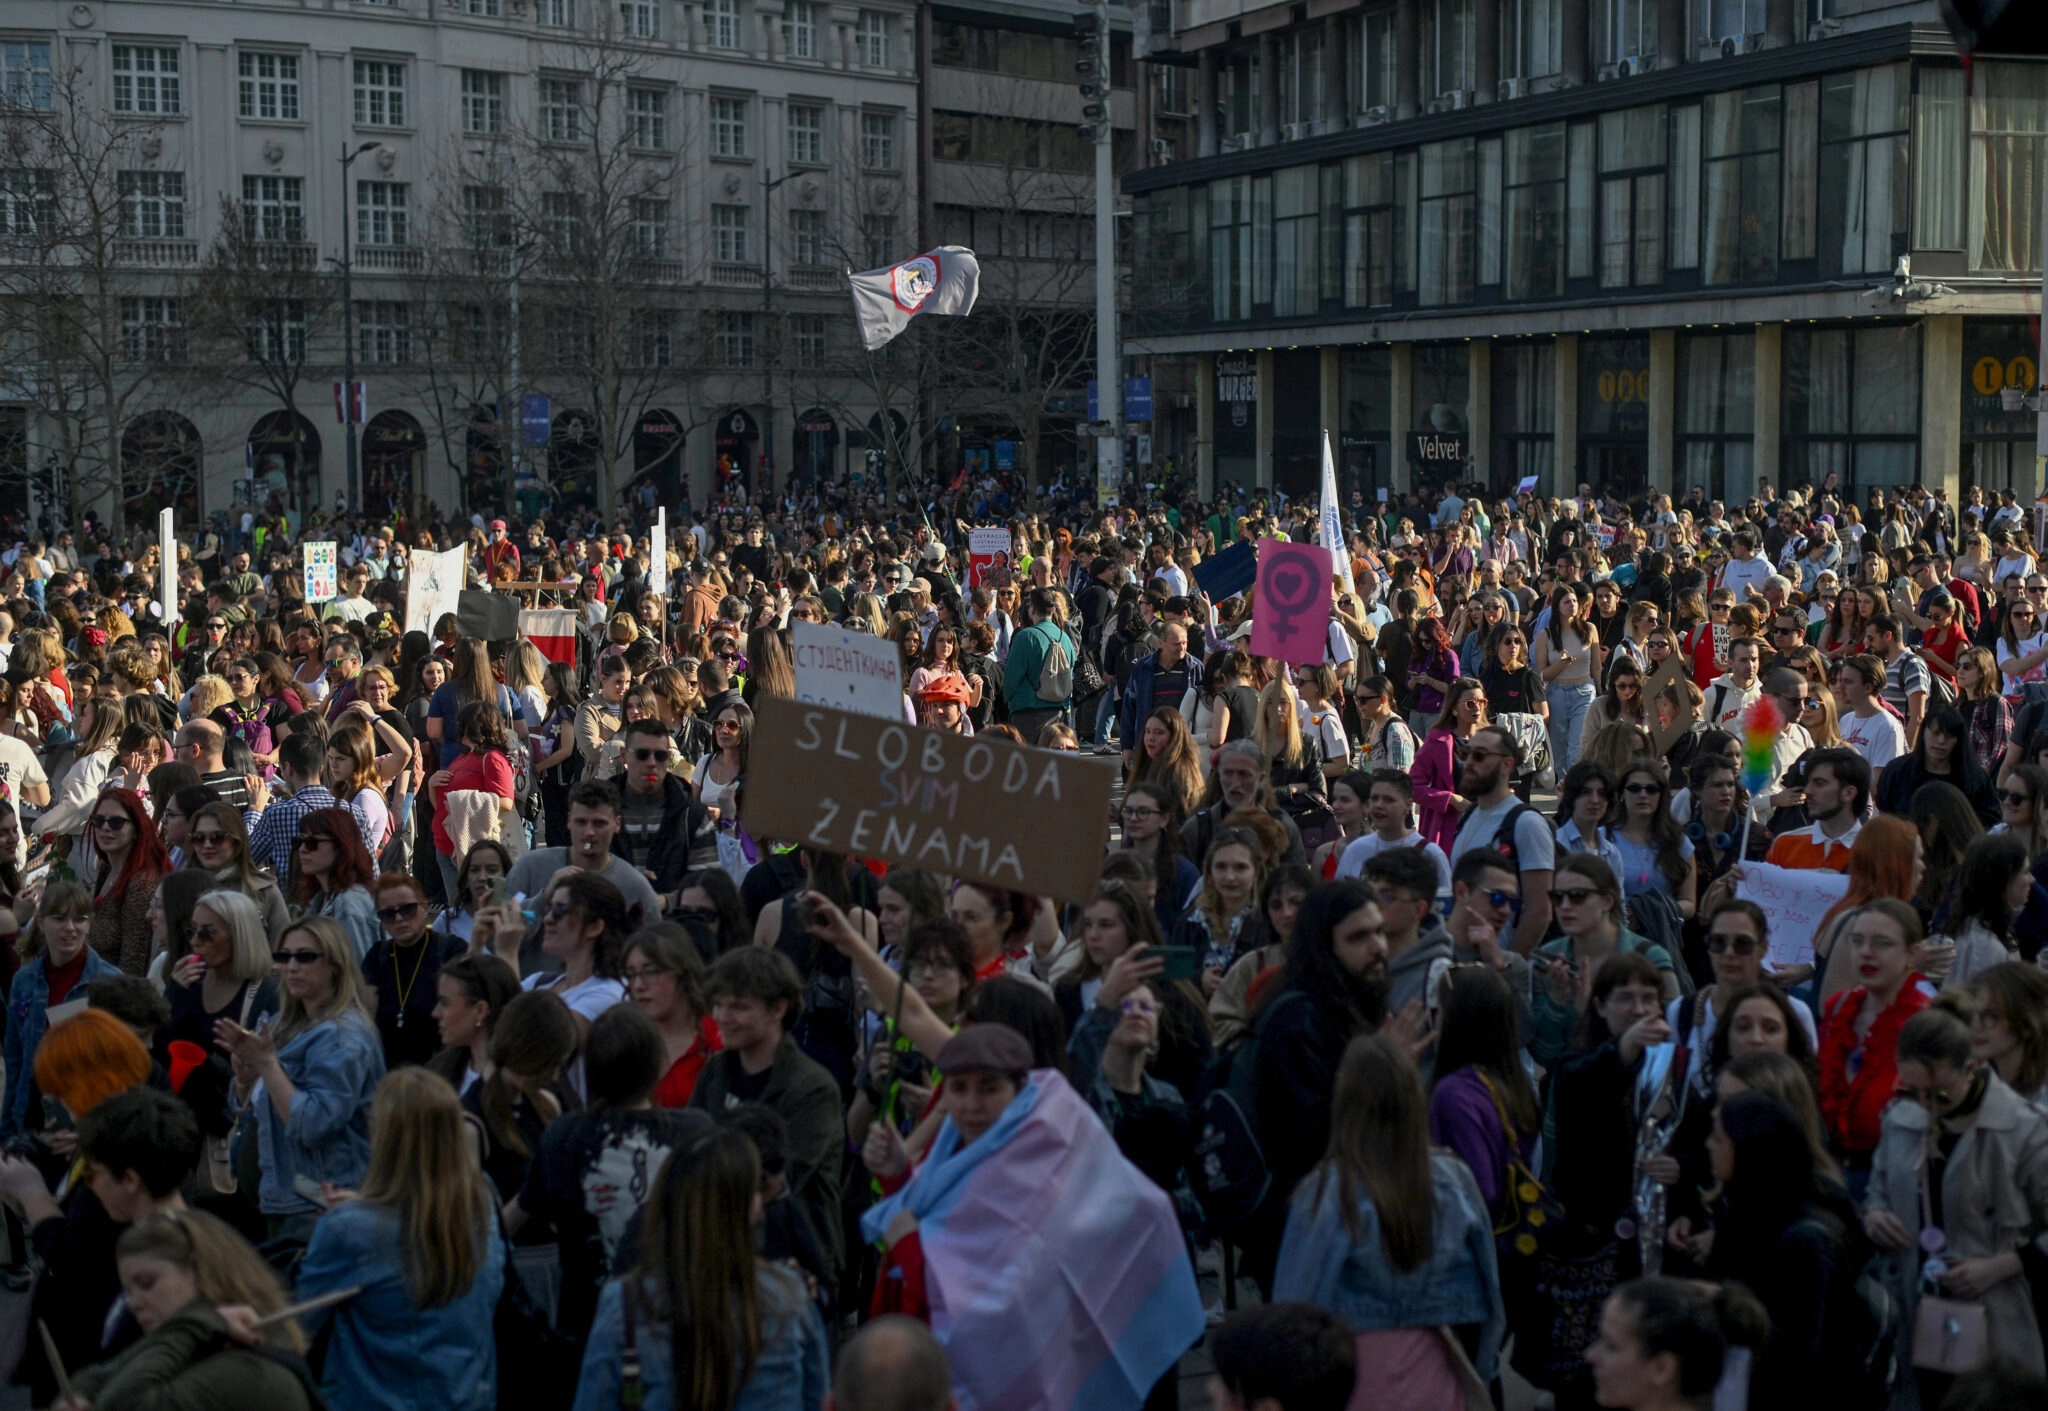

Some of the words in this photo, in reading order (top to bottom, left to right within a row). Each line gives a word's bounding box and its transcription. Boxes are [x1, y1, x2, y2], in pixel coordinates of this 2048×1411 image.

[1216, 353, 1248, 376] Smash
[1418, 435, 1461, 460] Velvet
[796, 643, 897, 683] СТУДЕНТКИЊА
[794, 712, 1062, 801] SLOBODA
[879, 769, 960, 820] SVIM
